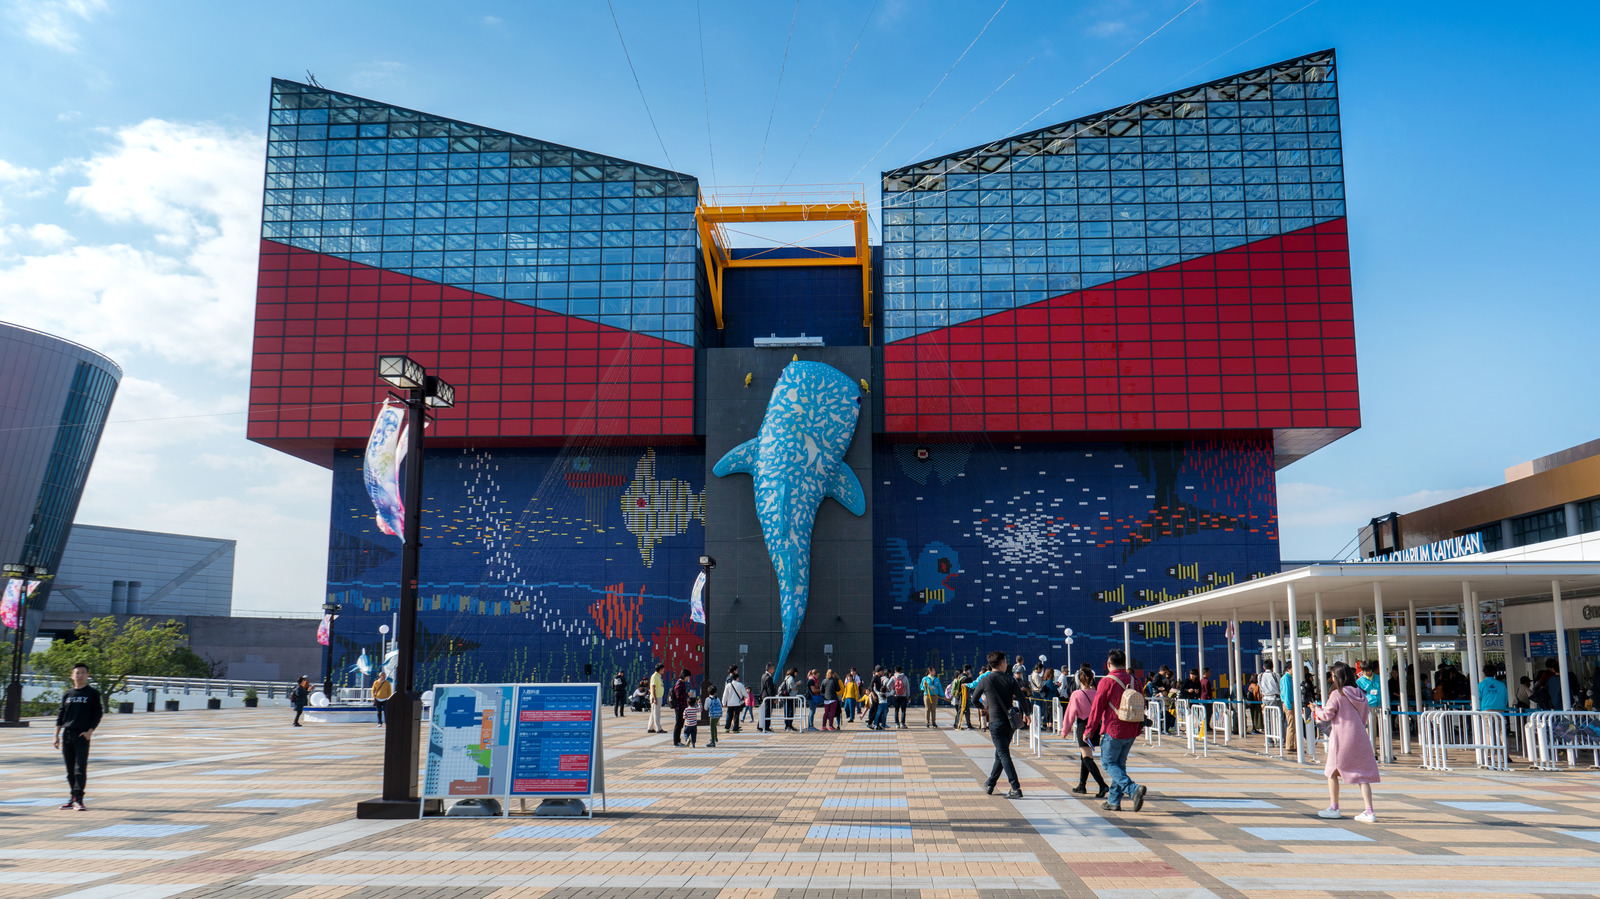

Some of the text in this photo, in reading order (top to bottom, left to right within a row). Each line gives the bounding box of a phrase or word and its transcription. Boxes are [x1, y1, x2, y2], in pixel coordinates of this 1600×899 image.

[1389, 544, 1430, 562] AQUARIUM
[1431, 532, 1481, 561] KAIYUKAN
[1485, 639, 1504, 647] GATE
